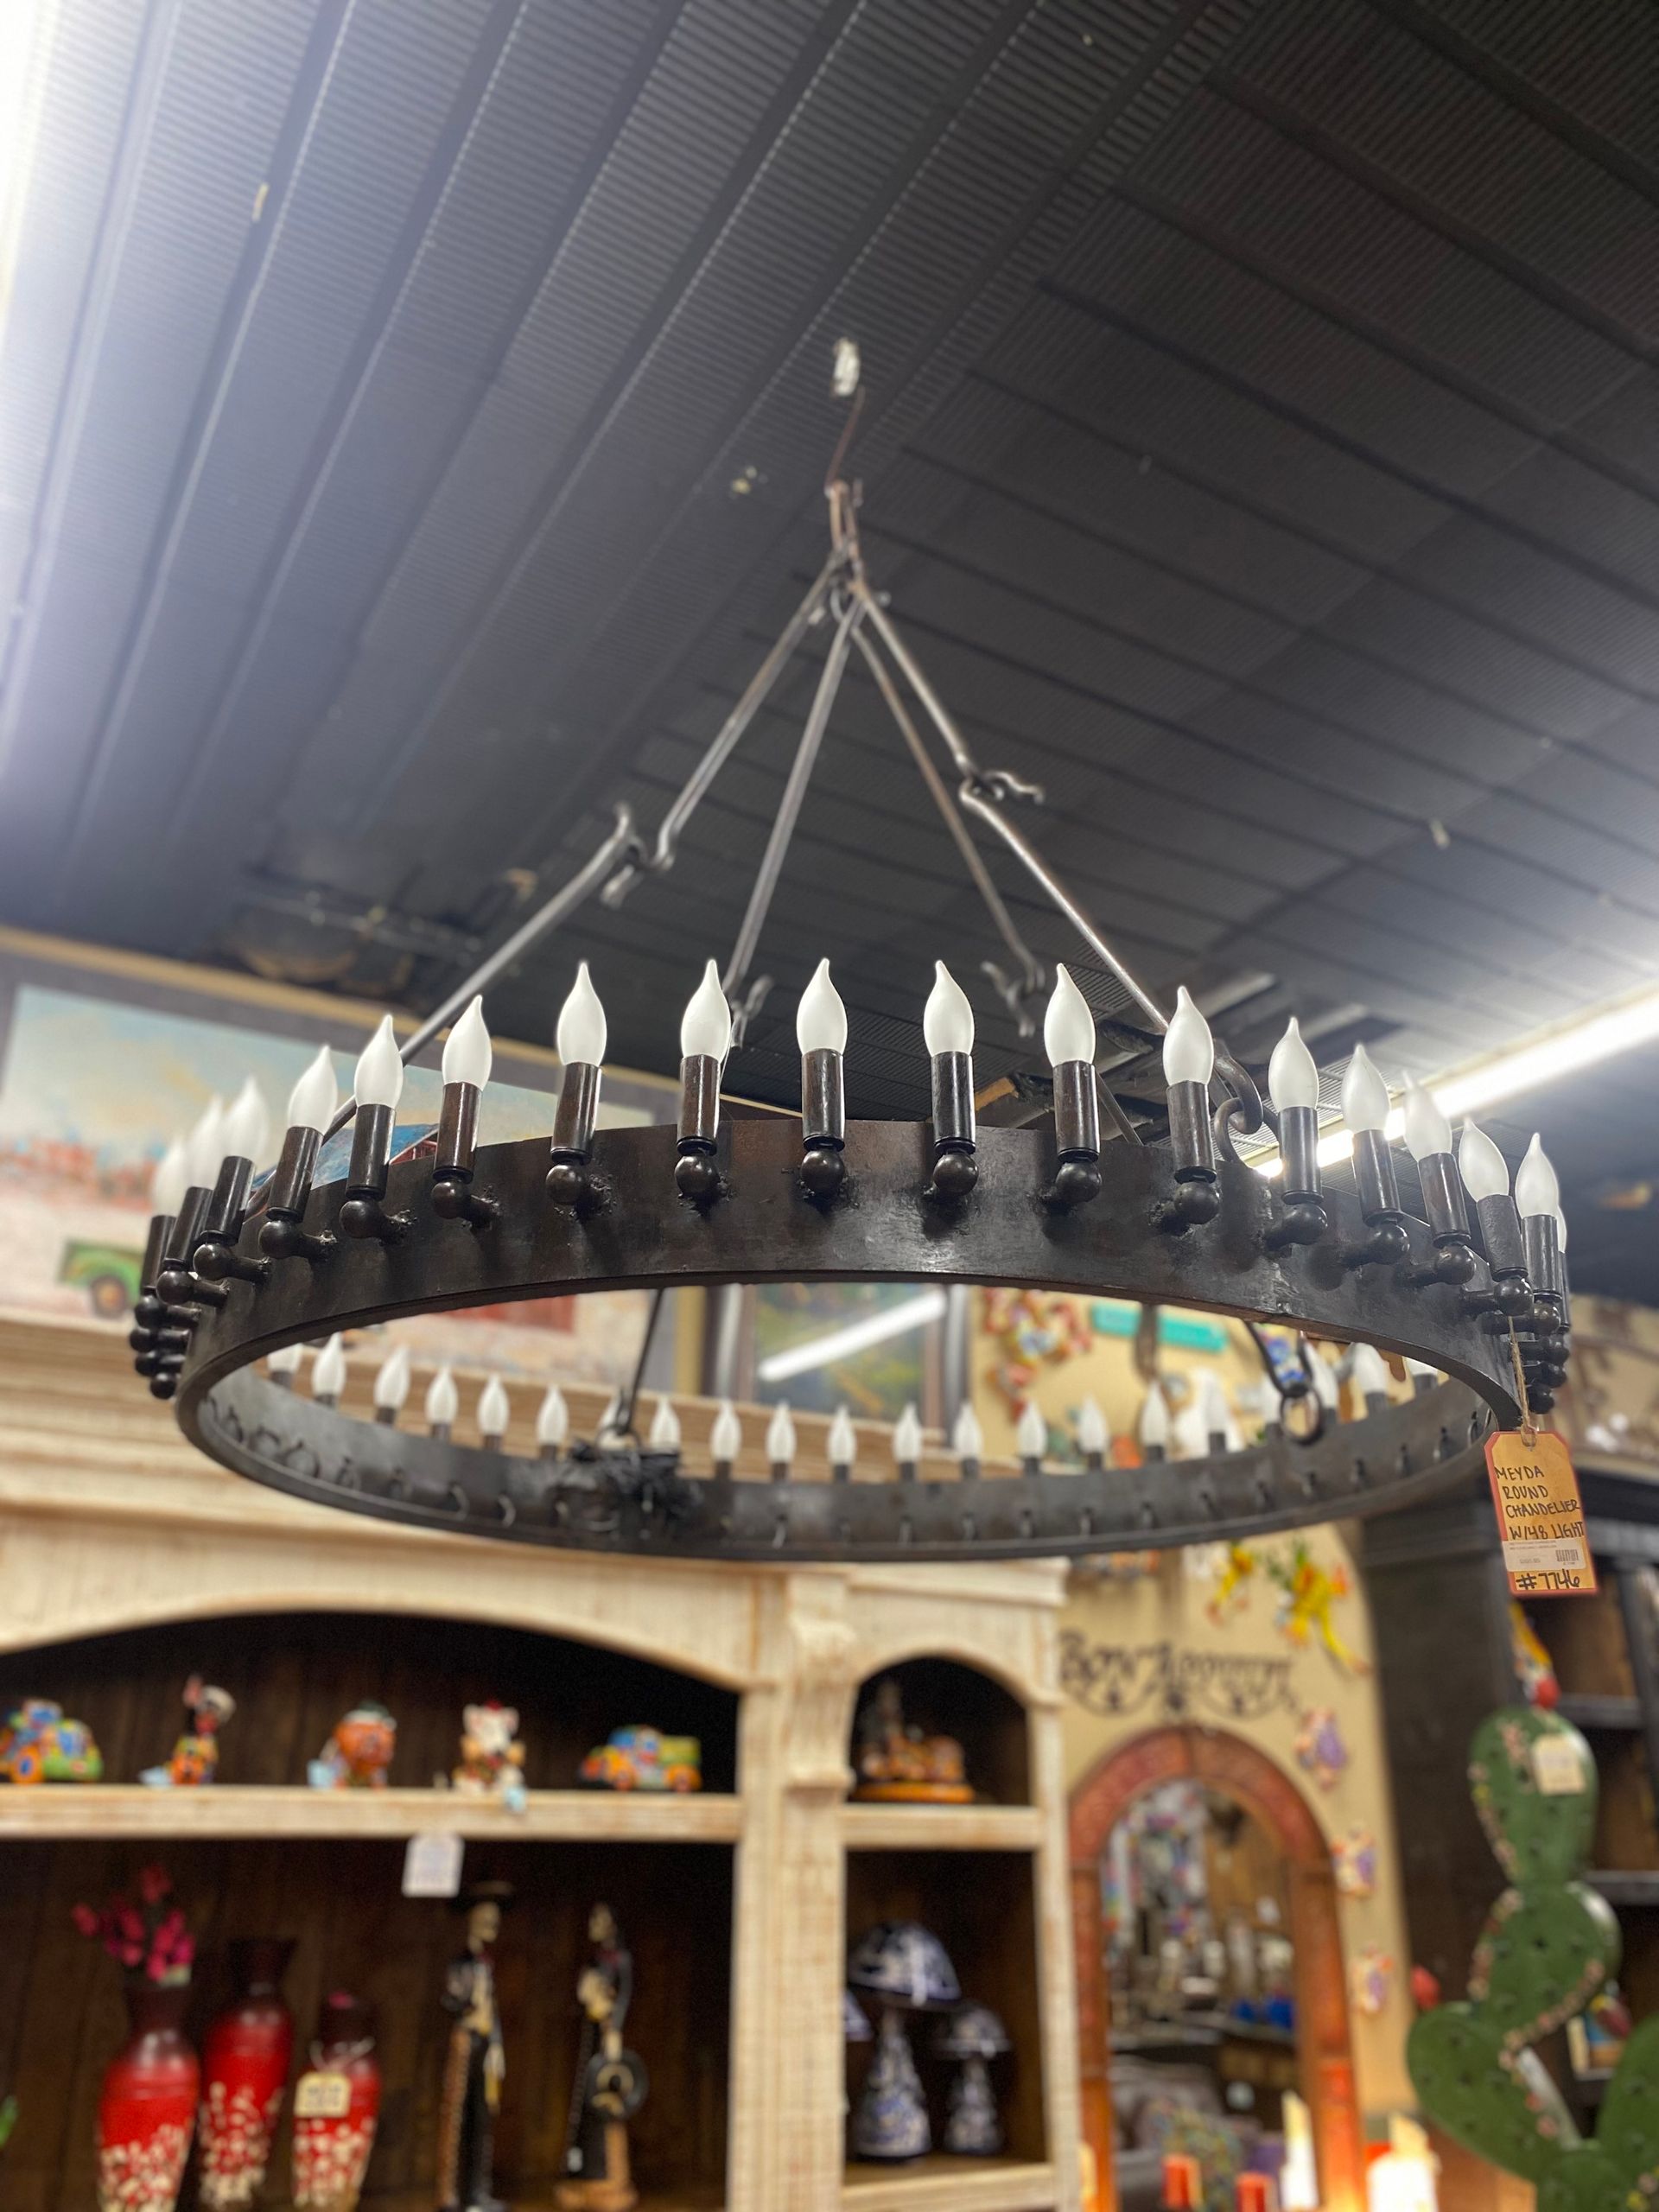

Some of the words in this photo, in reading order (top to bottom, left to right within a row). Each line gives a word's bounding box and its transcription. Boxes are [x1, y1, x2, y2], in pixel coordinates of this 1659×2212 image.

[1494, 1465, 1544, 1481] MEYDA
[1503, 1485, 1548, 1500] ROUND
[1505, 1499, 1580, 1518] CHANDELIER
[1510, 1525, 1548, 1541] W/48
[1551, 1521, 1585, 1539] LIGHT
[1516, 1568, 1580, 1589] #7746
